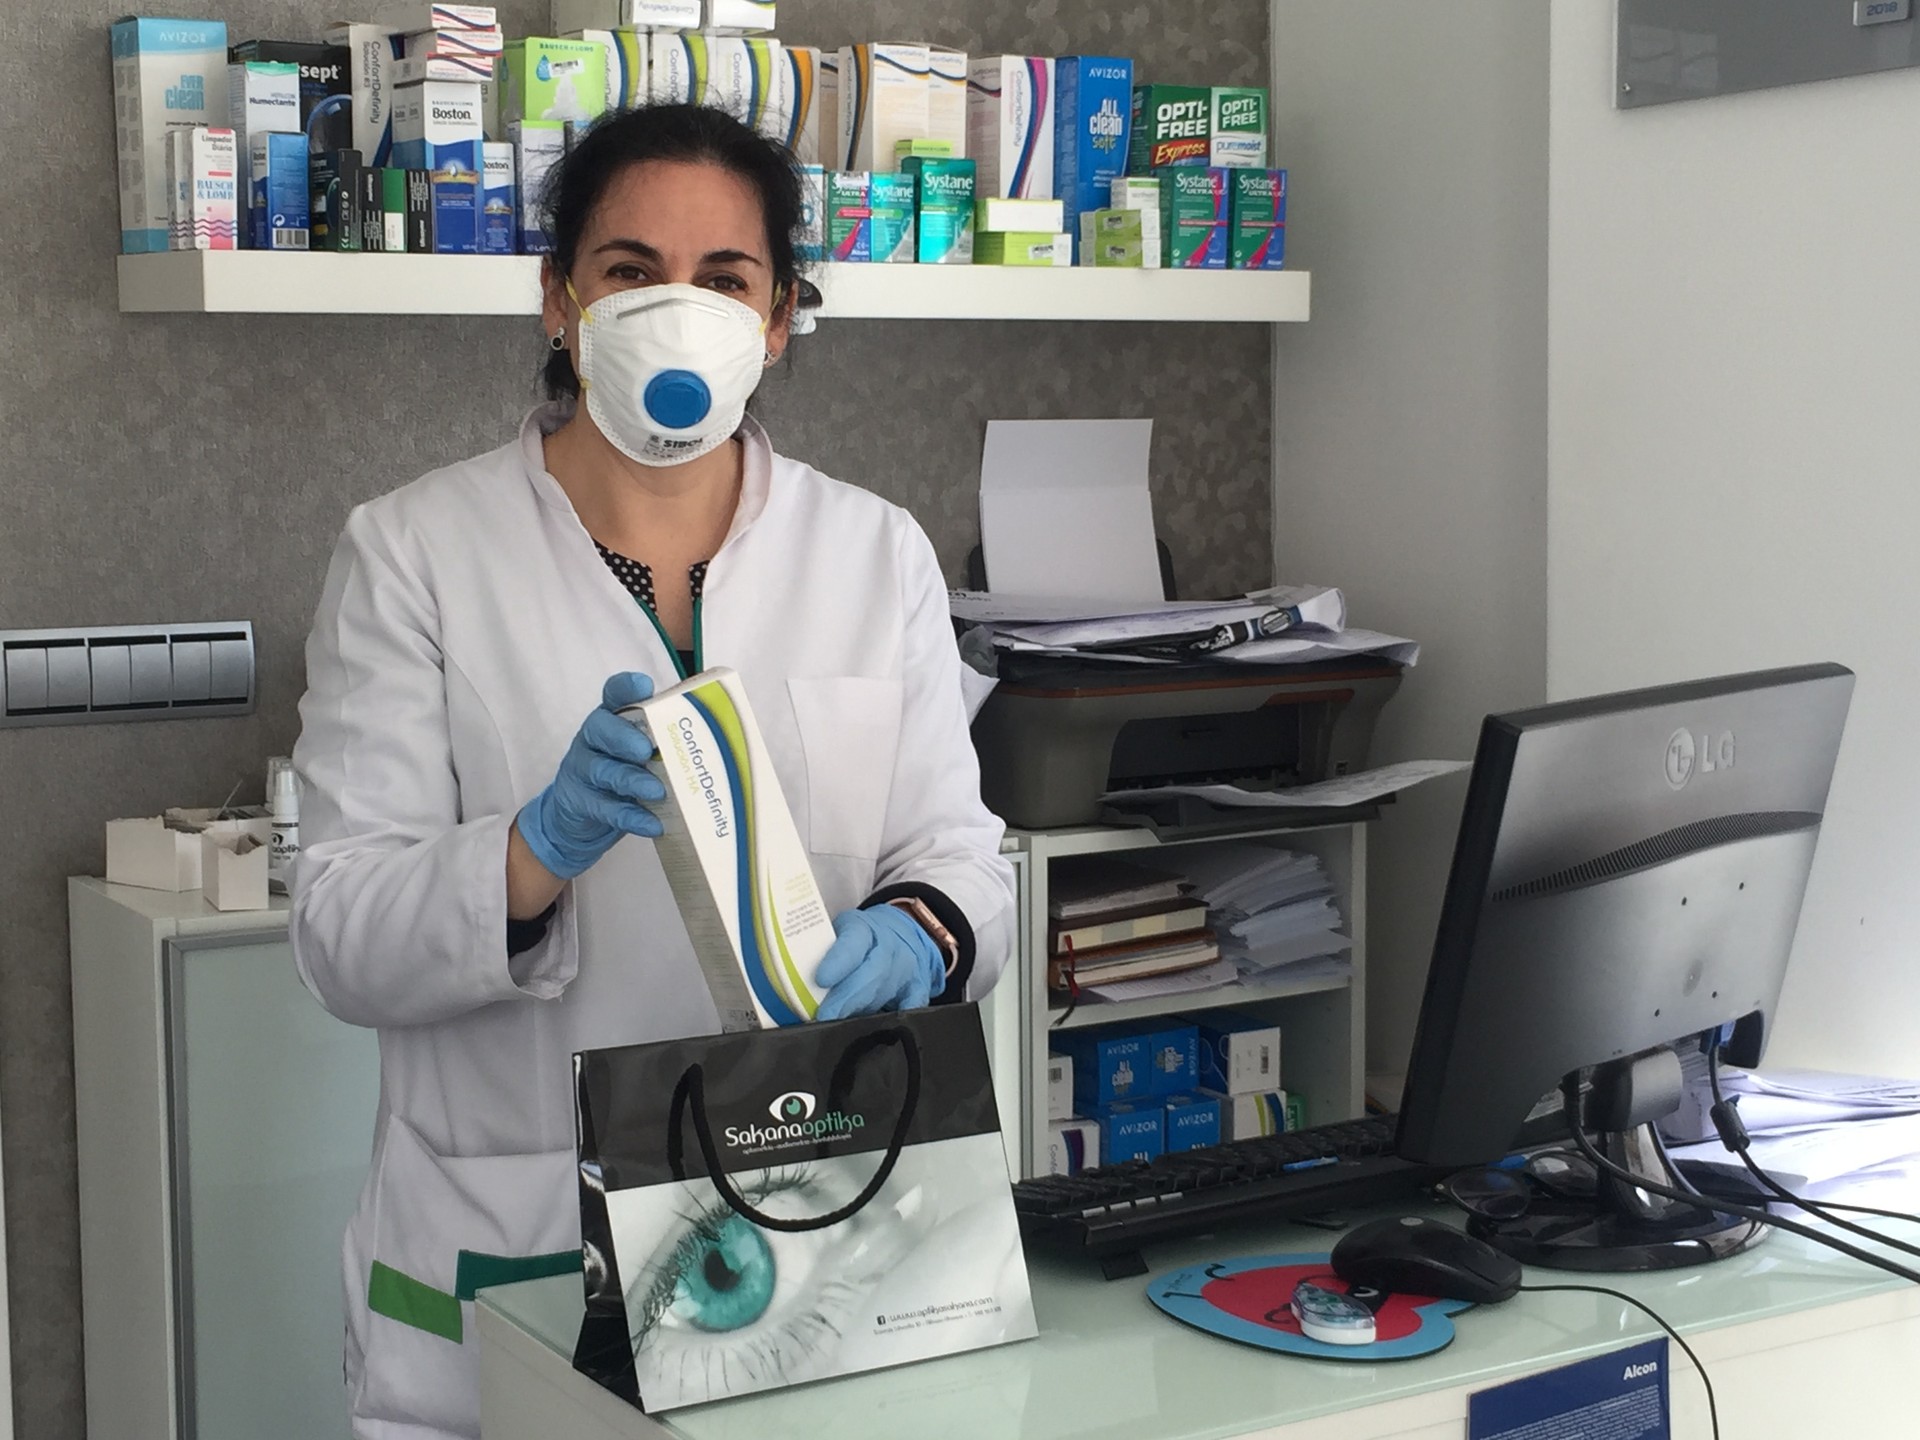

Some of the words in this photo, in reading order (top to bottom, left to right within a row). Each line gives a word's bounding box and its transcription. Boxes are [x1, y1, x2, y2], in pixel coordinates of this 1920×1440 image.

[1867, 1, 1898, 16] 2018
[160, 32, 207, 43] AVIZOR
[301, 65, 339, 83] sept
[370, 41, 381, 124] ConfortDefinity
[1089, 68, 1127, 79] AVIZOR
[432, 108, 472, 119] Boston
[1014, 70, 1024, 147] ConfortDefinity
[1101, 98, 1118, 117] ALL
[1157, 100, 1208, 122] OPTI-
[1221, 98, 1257, 115] OPTI-
[1089, 112, 1123, 136] clean
[1156, 119, 1208, 139] FREE
[1222, 111, 1257, 128] FREE
[1155, 143, 1206, 166] Express
[197, 180, 234, 190] BAUSCH
[924, 171, 971, 195] Systane
[1176, 172, 1217, 192] Systane
[1239, 175, 1278, 194] Systane
[872, 184, 913, 203] Systane
[667, 722, 691, 774] Solución
[687, 775, 700, 796] HA
[1702, 730, 1735, 773] LG
[678, 717, 729, 838] ConfortDefinity
[1107, 1042, 1139, 1056] AVIZOR
[725, 1111, 865, 1147] Sakanaoptika
[1119, 1120, 1157, 1135] AVIZOR
[1177, 1112, 1214, 1127] AVIZOR
[1049, 1143, 1058, 1173] Confo
[1624, 1361, 1657, 1380] Alcon
